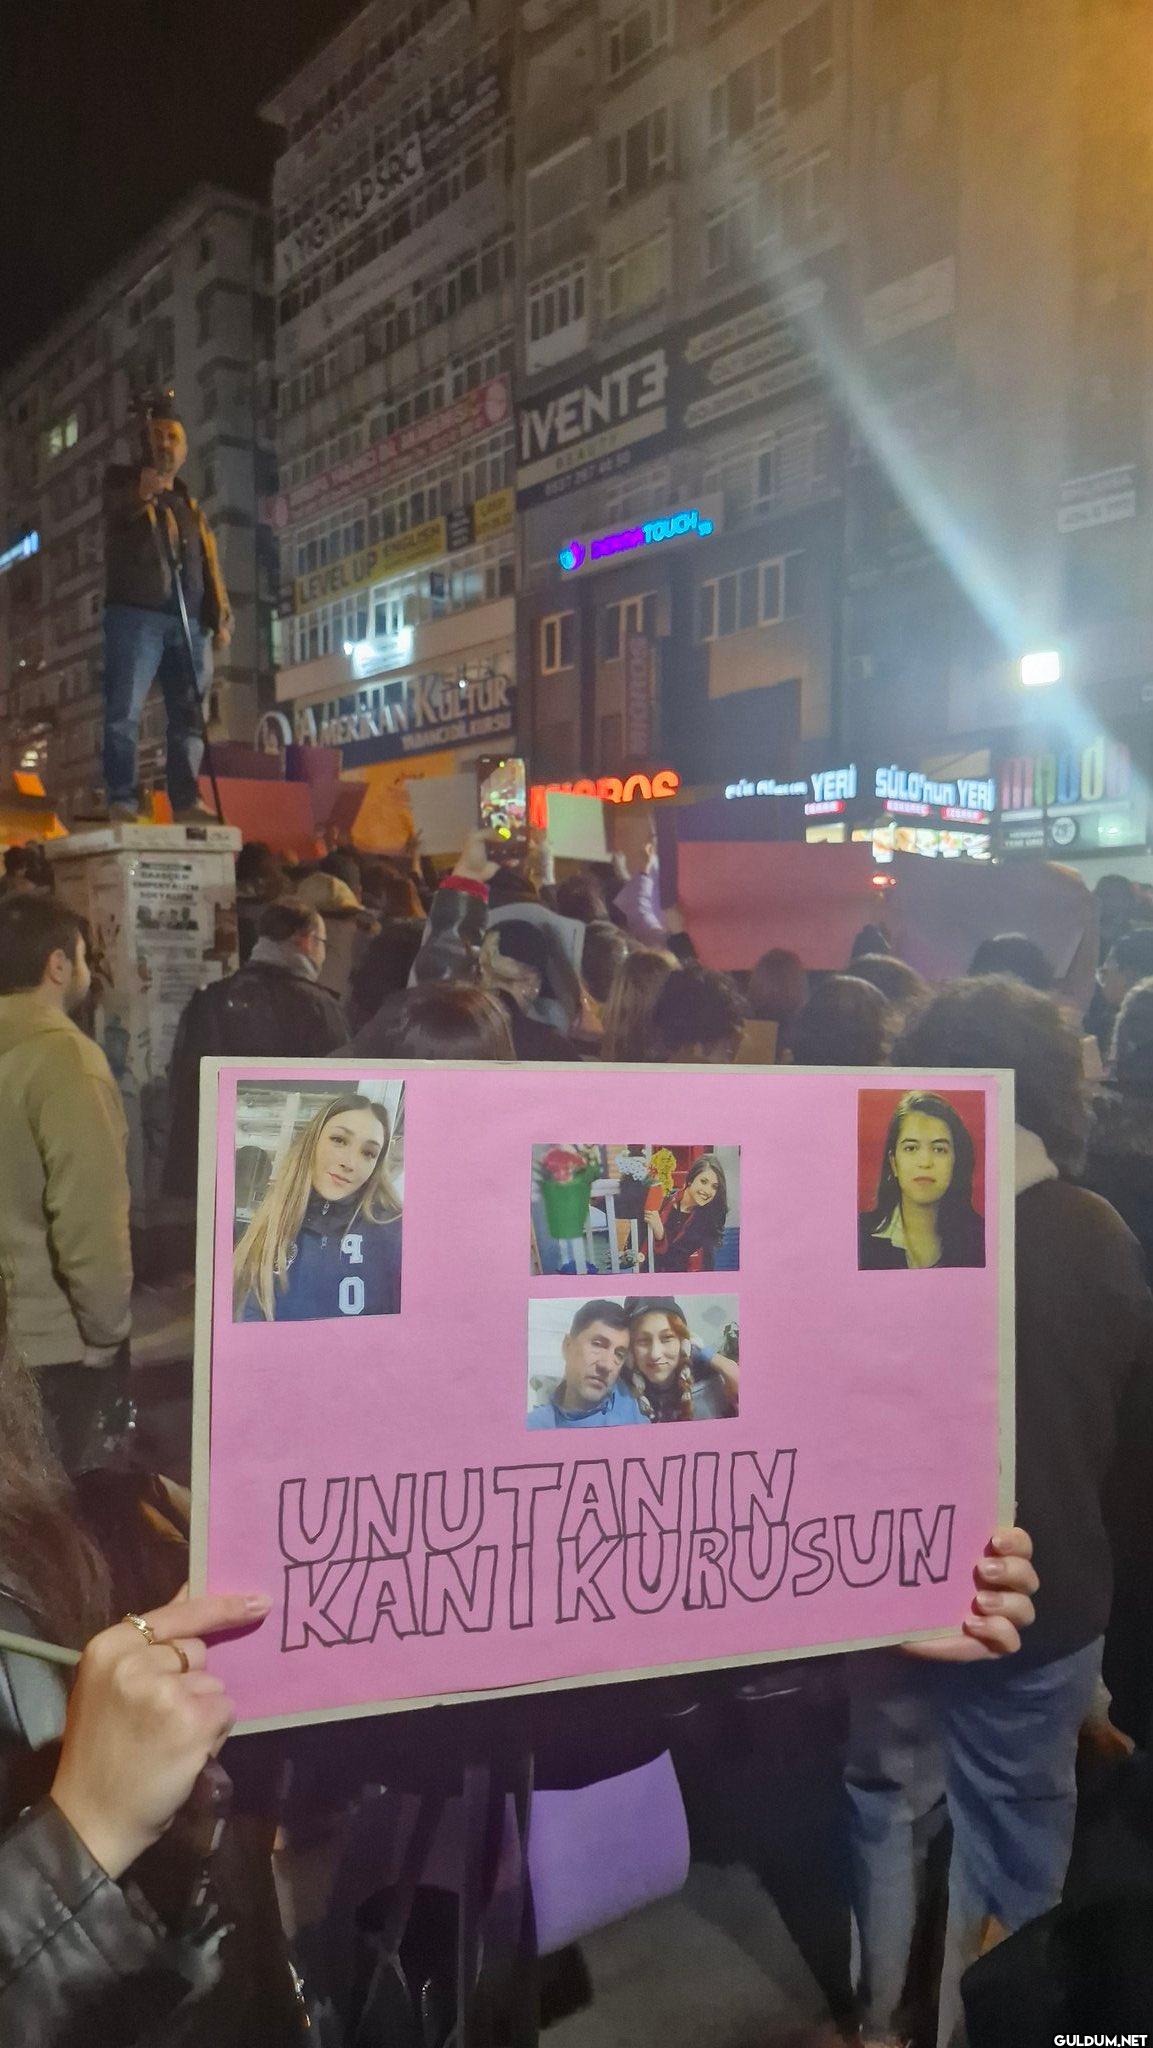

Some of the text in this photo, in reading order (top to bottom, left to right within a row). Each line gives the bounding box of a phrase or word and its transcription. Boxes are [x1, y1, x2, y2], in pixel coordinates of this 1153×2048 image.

[279, 1448, 797, 1563] UNUTANIN
[278, 1504, 956, 1652] KANI KURUSUN
